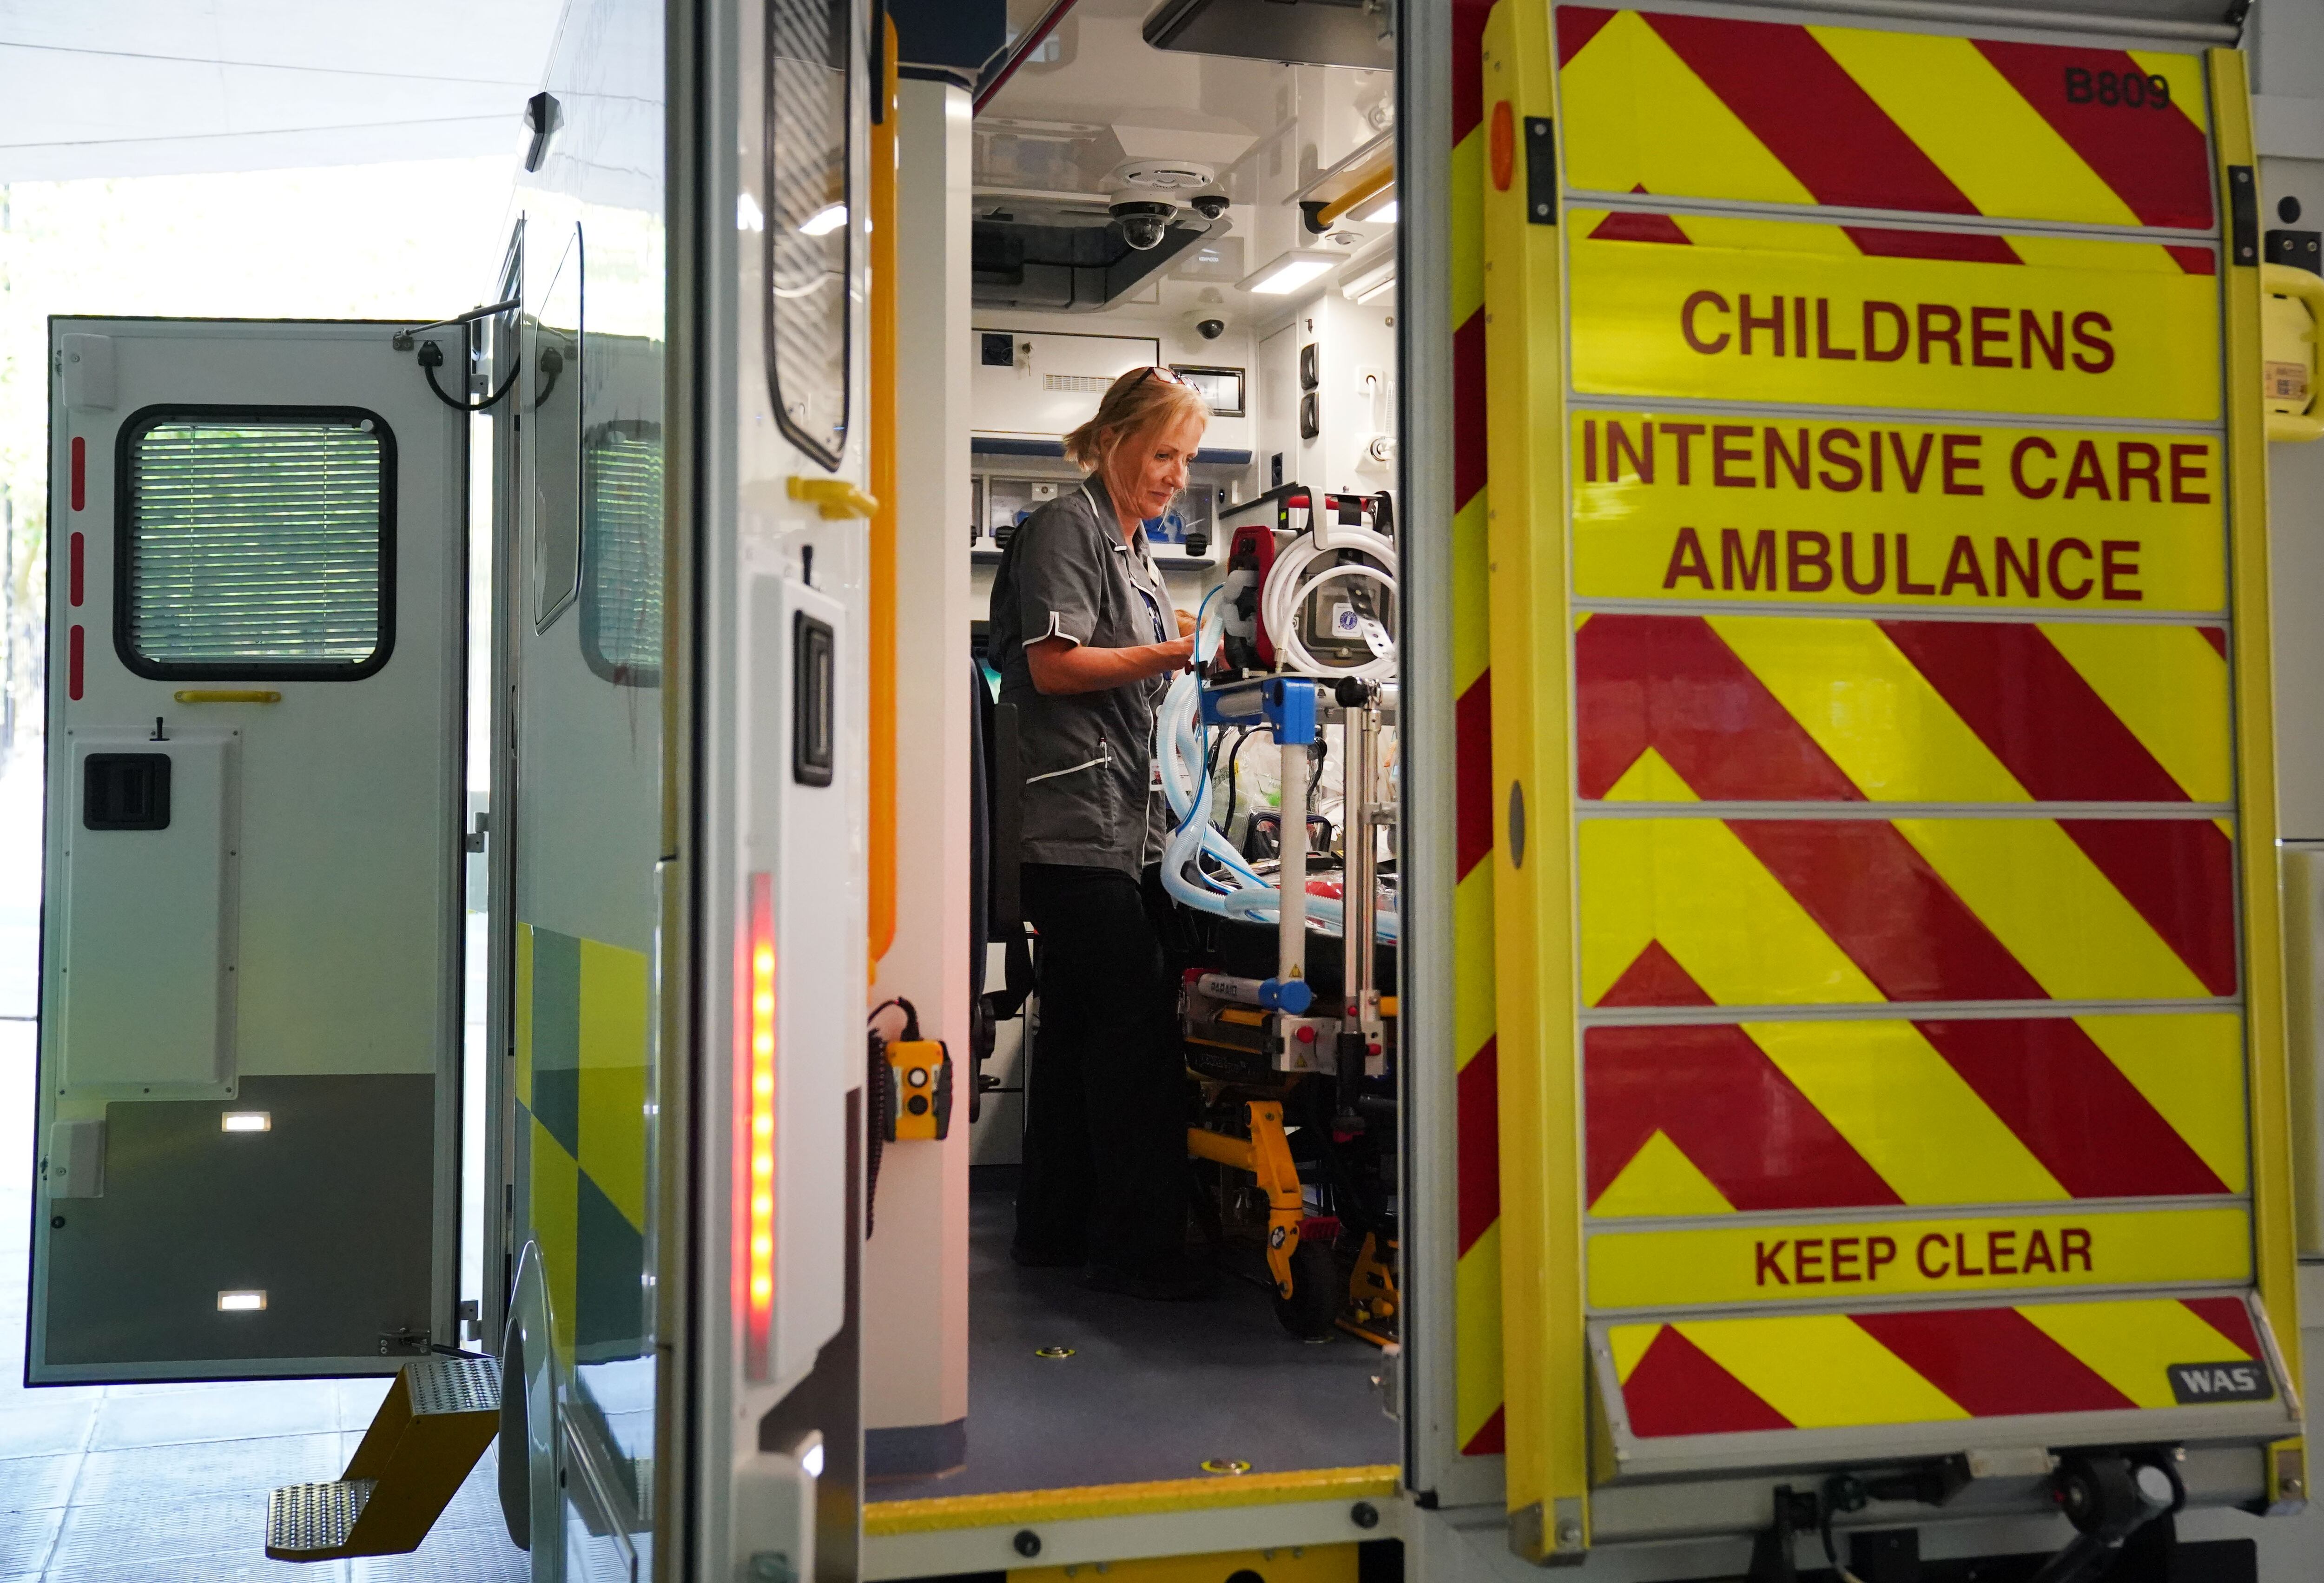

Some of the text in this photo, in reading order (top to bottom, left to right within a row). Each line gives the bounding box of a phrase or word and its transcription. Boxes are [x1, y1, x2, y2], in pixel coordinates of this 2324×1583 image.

[2065, 67, 2170, 109] B809
[1682, 290, 2115, 375] CHILDRENS
[1584, 420, 2211, 505] INTENSIVE CARE
[1663, 527, 2144, 601] AMBULANCE
[1755, 1227, 2093, 1286] KEEP CLEAR
[2179, 1368, 2257, 1393] WAS
